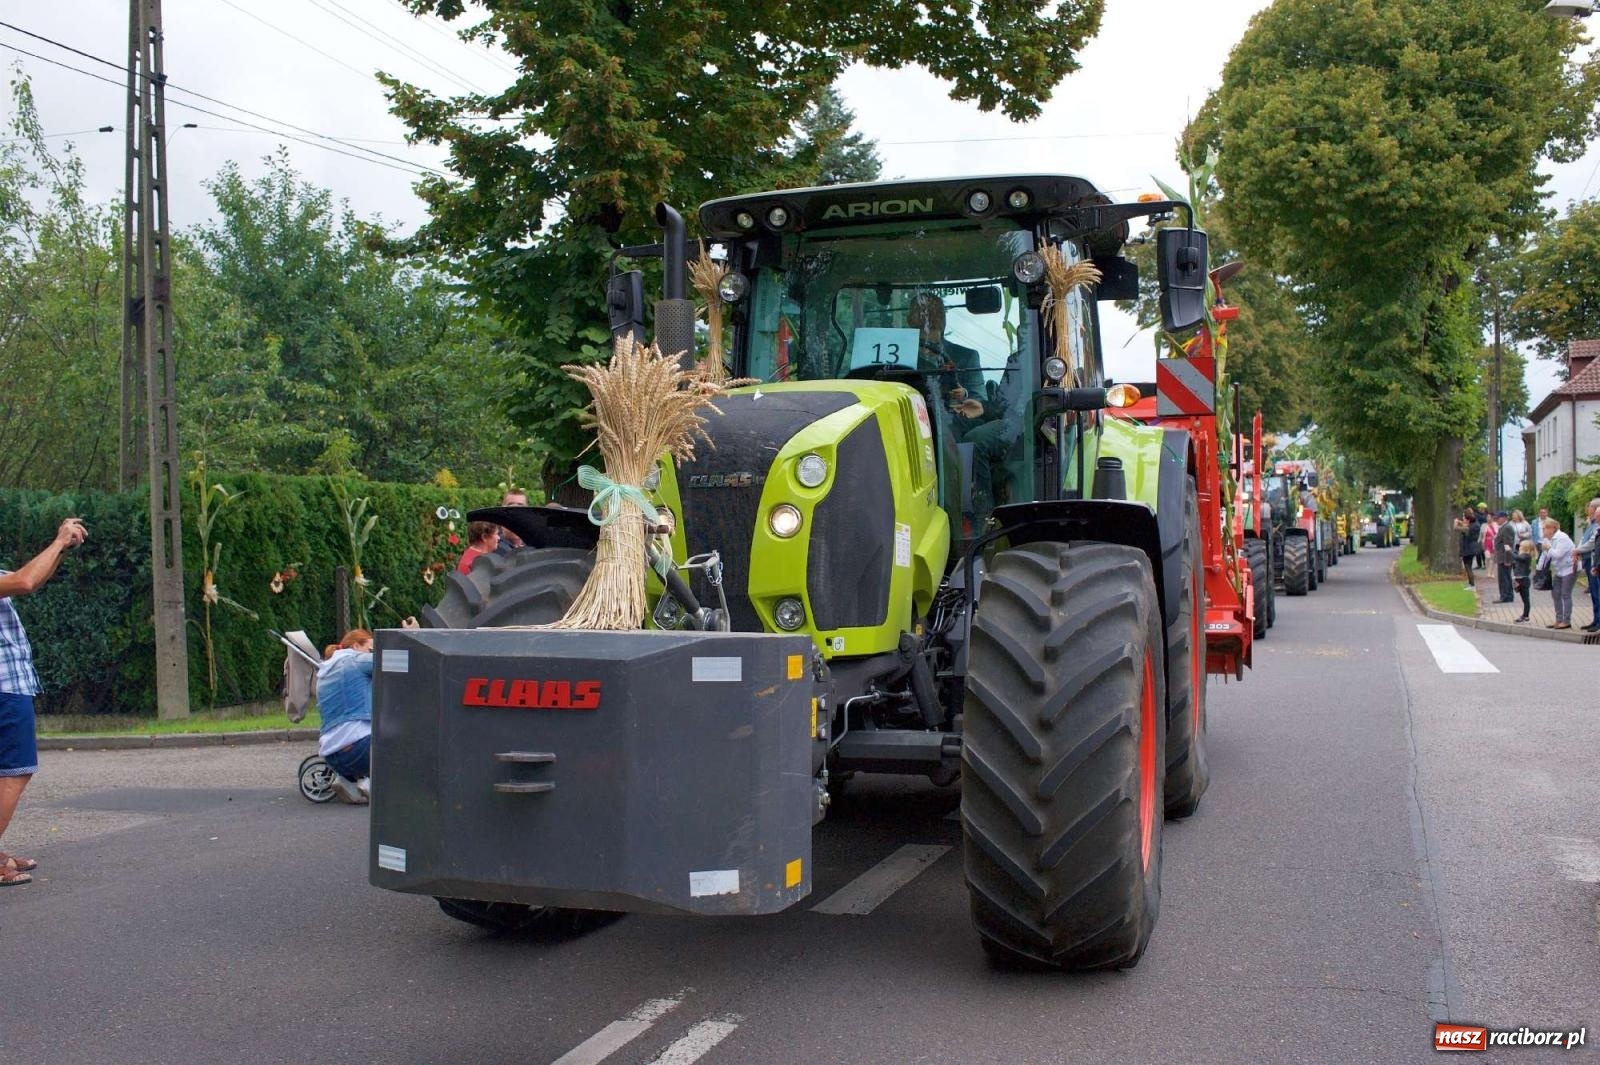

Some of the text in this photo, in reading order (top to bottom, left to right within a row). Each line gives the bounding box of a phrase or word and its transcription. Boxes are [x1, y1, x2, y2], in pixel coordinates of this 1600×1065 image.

[821, 198, 934, 220] ARION
[871, 342, 900, 364] 13
[462, 678, 602, 710] CLAAS
